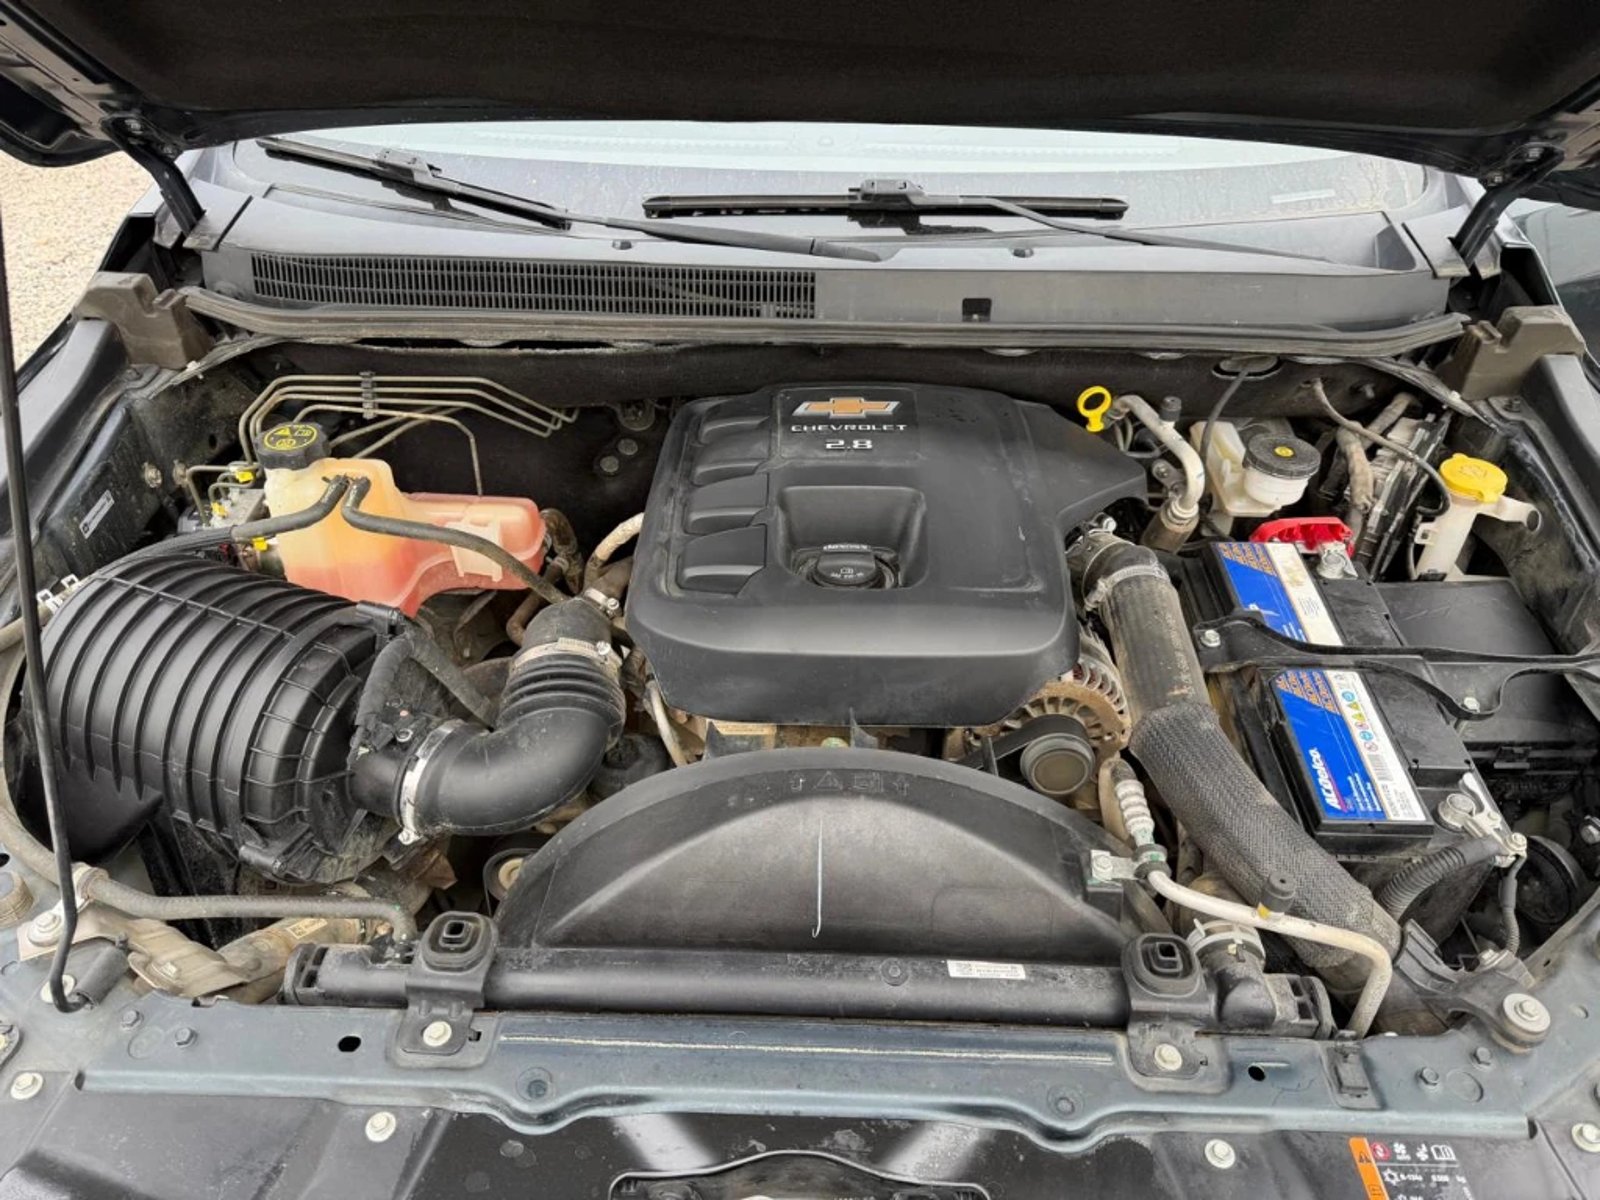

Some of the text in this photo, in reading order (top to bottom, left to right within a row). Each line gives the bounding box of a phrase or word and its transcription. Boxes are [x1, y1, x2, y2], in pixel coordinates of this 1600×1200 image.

[790, 424, 908, 432] CHEVROLET
[825, 438, 873, 450] 2.8
[1309, 748, 1341, 811] ACDelco
